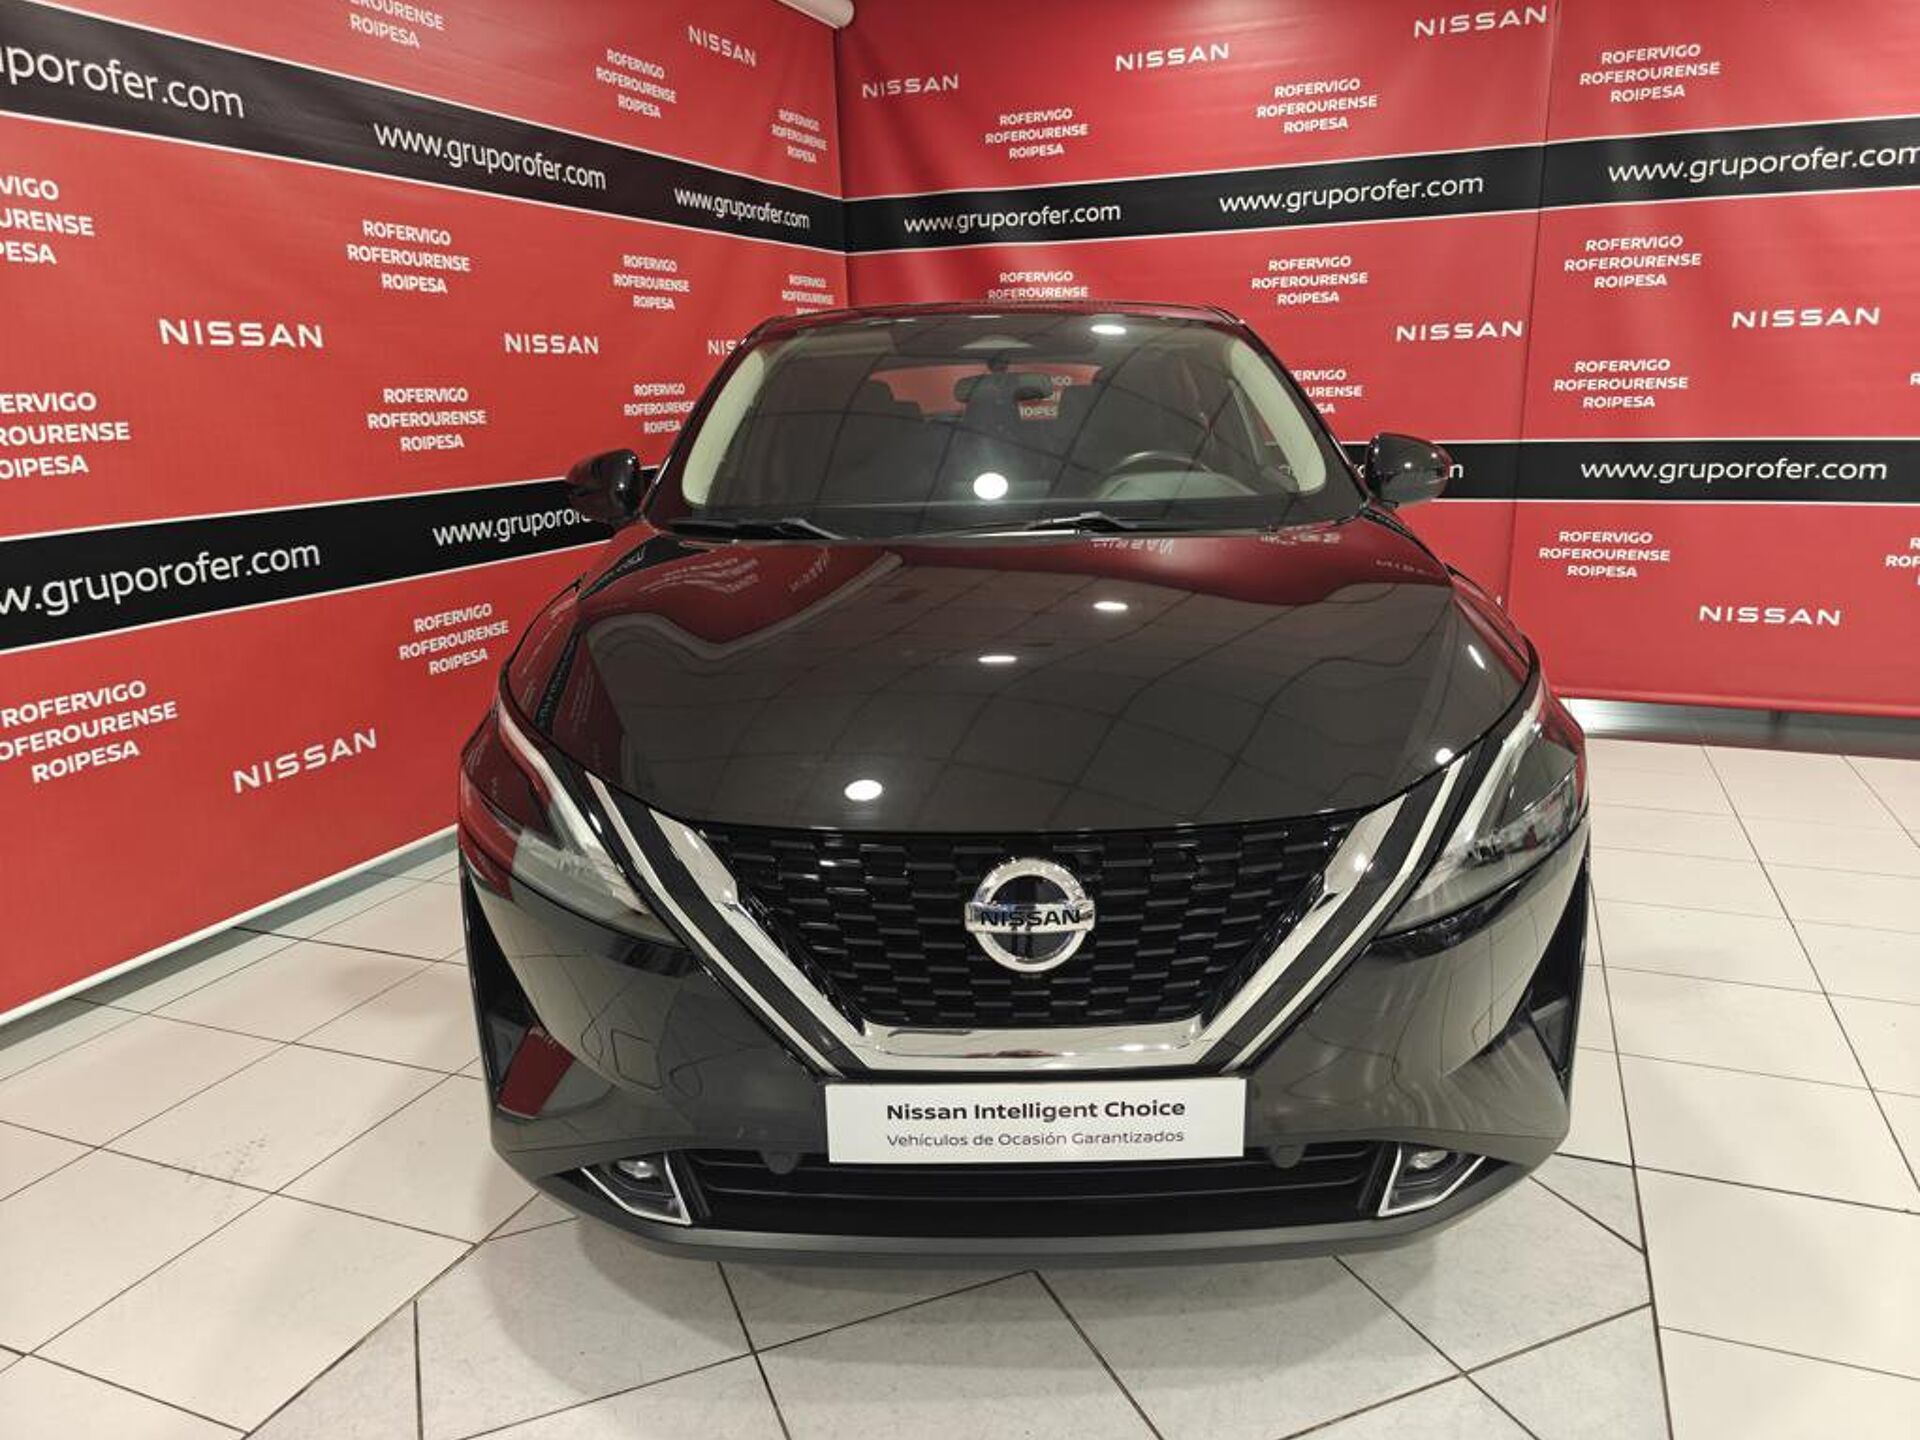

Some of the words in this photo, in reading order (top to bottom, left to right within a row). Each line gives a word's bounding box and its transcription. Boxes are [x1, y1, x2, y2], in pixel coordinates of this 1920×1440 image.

[350, 13, 420, 48] ROIPESA
[1414, 5, 1548, 38] NISSAN
[688, 25, 756, 66] NISSAN
[1601, 44, 1701, 65] ROFERVIGO
[1116, 43, 1229, 71] NISSAN
[0, 46, 244, 118] porofer.com
[1579, 61, 1721, 85] ROFEROURENSE
[862, 74, 958, 98] NISSAN
[1275, 78, 1360, 98] ROFERVIGO
[1610, 84, 1685, 102] ROIPESA
[1000, 107, 1073, 126] ROFERVIGO
[1256, 94, 1378, 118] ROFEROURENSE
[985, 123, 1088, 144] ROFEROURENSE
[1284, 116, 1349, 134] ROIPESA
[374, 123, 606, 190] www.gruporofer.com
[1009, 143, 1065, 159] ROIPESA
[1219, 176, 1484, 213] www.gruporofer.com
[674, 187, 810, 229] www.gruporofer.com
[904, 205, 1121, 234] www.gruporofer.com
[362, 219, 451, 246] ROFERVIGO
[1585, 234, 1683, 252] ROFERVIGO
[346, 244, 471, 272] ROFEROURENSE
[1268, 255, 1352, 271] ROFERVIGO
[1564, 253, 1702, 272] ROFEROURENSE
[381, 272, 448, 293] ROIPESA
[999, 269, 1074, 283] ROFERVIGO
[1251, 272, 1368, 289] ROFEROURENSE
[1594, 272, 1667, 288] ROIPESA
[1277, 290, 1339, 305] ROIPESA
[1732, 307, 1880, 328] NISSAN
[159, 319, 323, 348] NISSAN
[1396, 320, 1523, 342] NISSAN
[504, 333, 599, 354] NISSAN
[1290, 368, 1347, 382] ERVIGO
[1574, 359, 1670, 373] ROFERVIGO
[1553, 376, 1688, 392] ROFEROURENSE
[383, 387, 469, 404] ROFERVIGO
[1583, 395, 1655, 409] ROIPESA
[367, 409, 487, 429] ROFEROURENSE
[401, 434, 465, 452] ROIPESA
[1580, 457, 1887, 483] www.gruporofer.com
[1559, 531, 1653, 545] ROFERVIGO
[1539, 545, 1670, 562] ROFEROURENSE
[1567, 564, 1638, 579] ROIPESA
[413, 603, 493, 633] ROFERVIGO
[1699, 606, 1841, 626] NISSAN
[398, 620, 509, 660] ROFEROURENSE
[428, 648, 489, 675] ROIPESA
[1, 680, 147, 728] ROFERVIGO
[31, 740, 140, 783] ROIPESA
[233, 728, 376, 793] NISSAN
[980, 907, 1081, 928] NISSAN
[887, 1104, 967, 1120] Nissan
[974, 1102, 1097, 1123] Intelligent
[1104, 1100, 1185, 1117] Choice
[887, 1133, 968, 1147] Vehículos
[973, 1131, 993, 1146] de
[998, 1131, 1067, 1146] Ocasión
[1071, 1129, 1184, 1145] Garantizados
